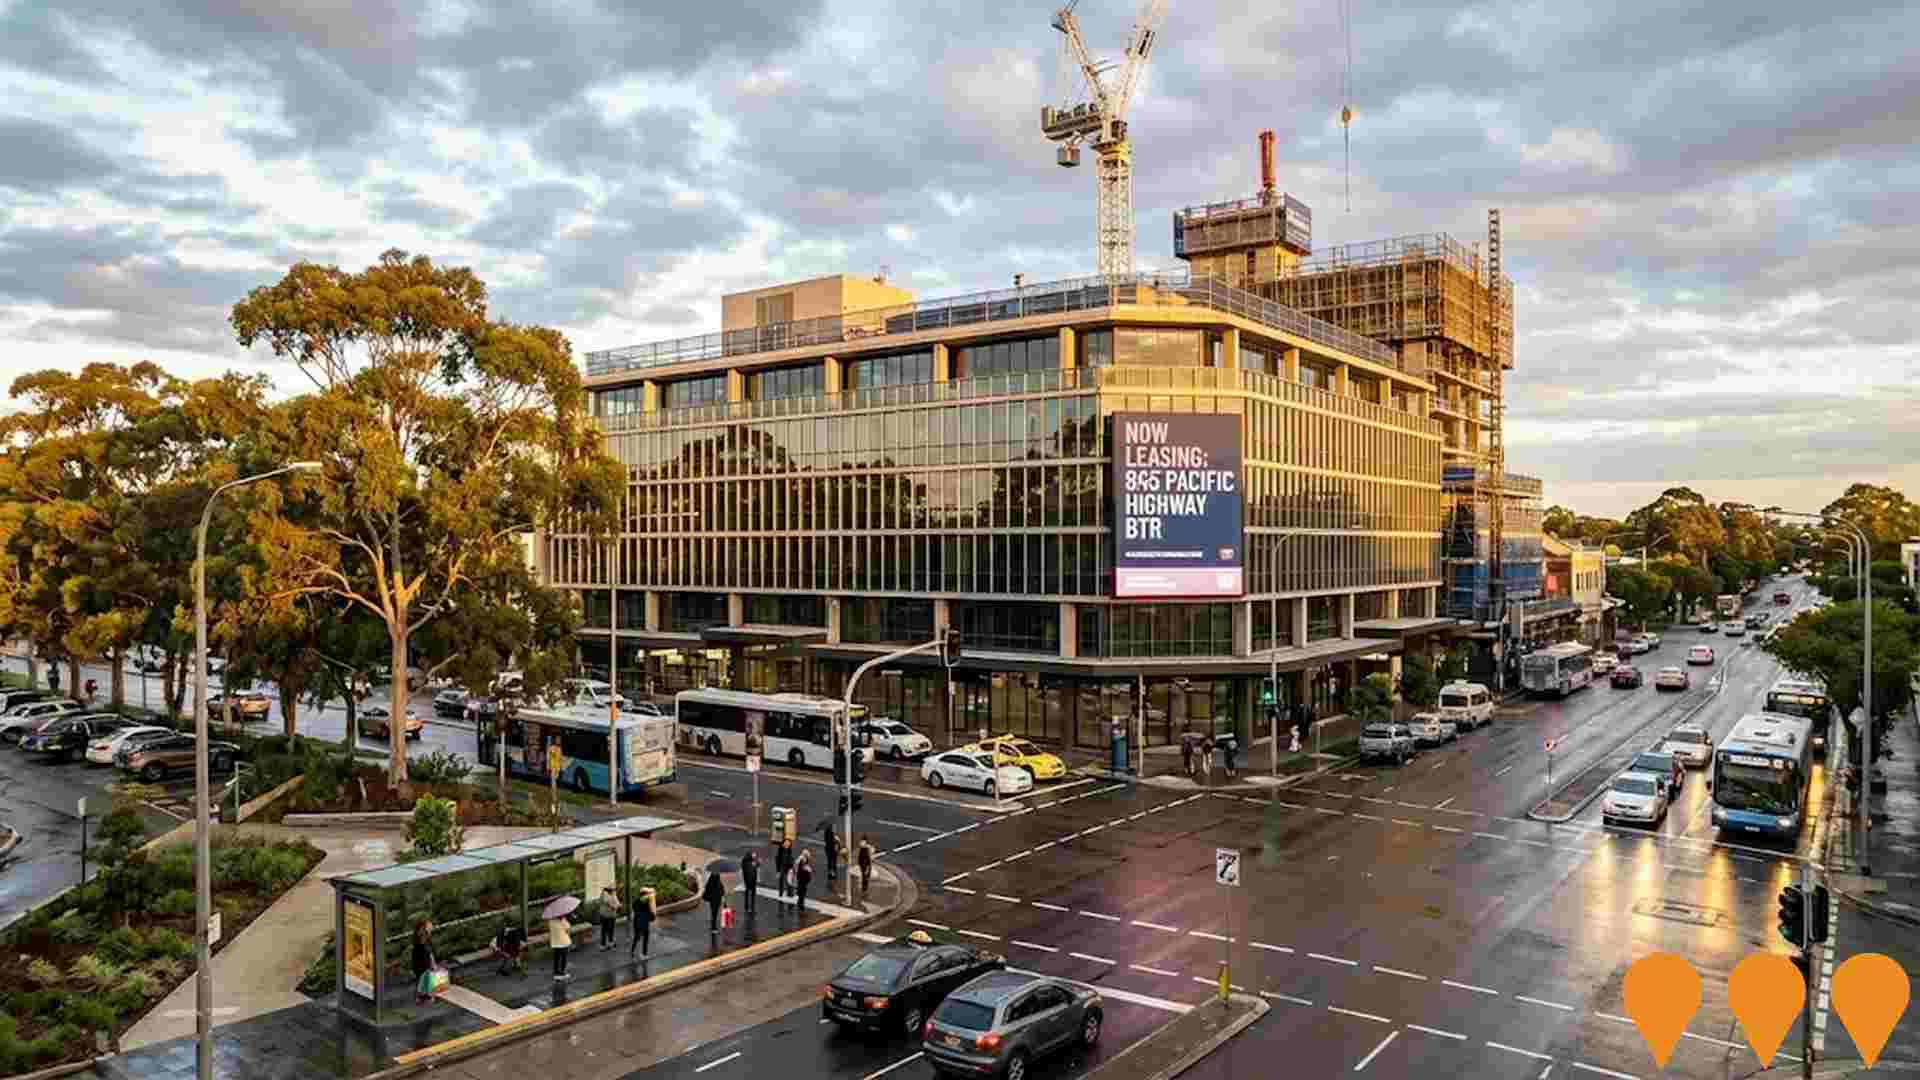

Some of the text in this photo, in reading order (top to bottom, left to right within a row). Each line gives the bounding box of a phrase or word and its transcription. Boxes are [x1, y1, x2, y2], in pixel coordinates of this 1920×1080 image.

[1125, 422, 1168, 444] NOW
[1165, 470, 1235, 492] PACIFIC
[1125, 494, 1208, 516] HIGHWAY
[1125, 517, 1162, 539] BTR
